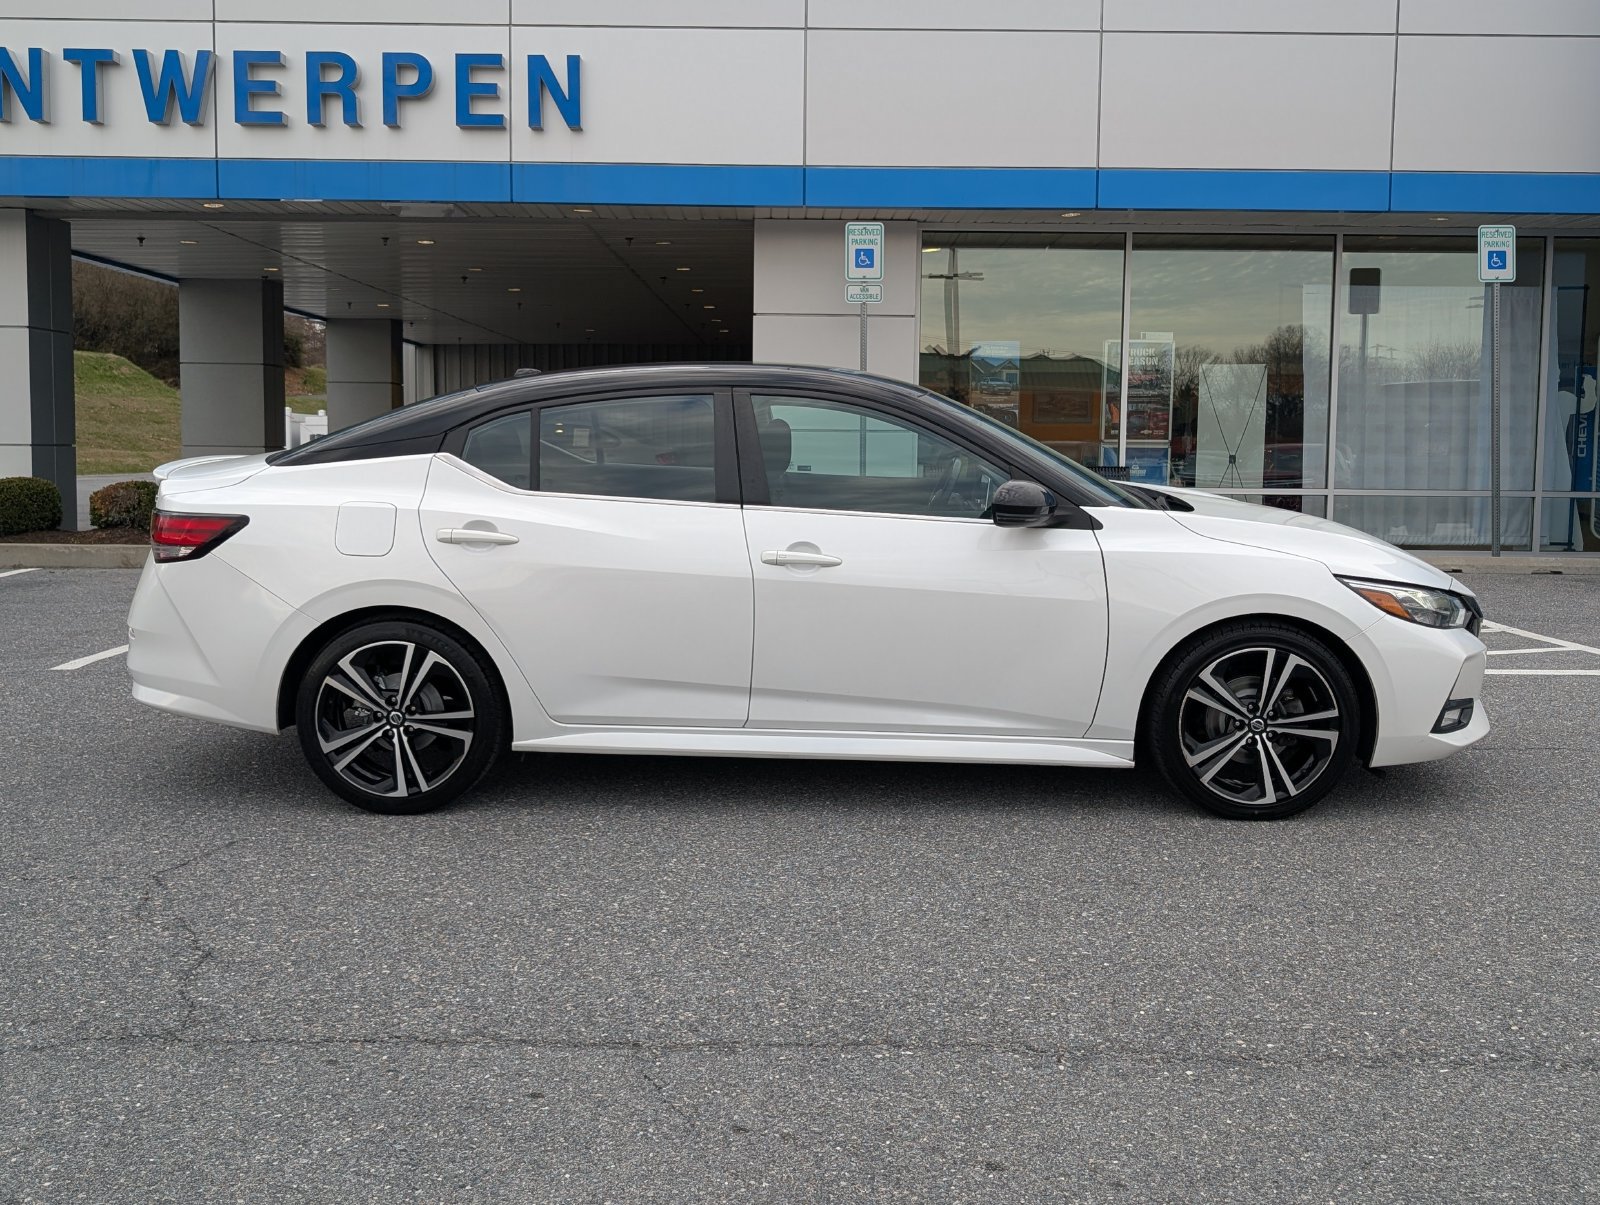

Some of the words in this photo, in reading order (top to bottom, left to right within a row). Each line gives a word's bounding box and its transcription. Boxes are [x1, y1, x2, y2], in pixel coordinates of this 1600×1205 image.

[848, 228, 881, 236] RESERVED
[1481, 231, 1512, 239] RESERVED
[1483, 240, 1510, 248] PARKING
[1129, 347, 1156, 357] RUCK
[1128, 356, 1159, 366] EASON
